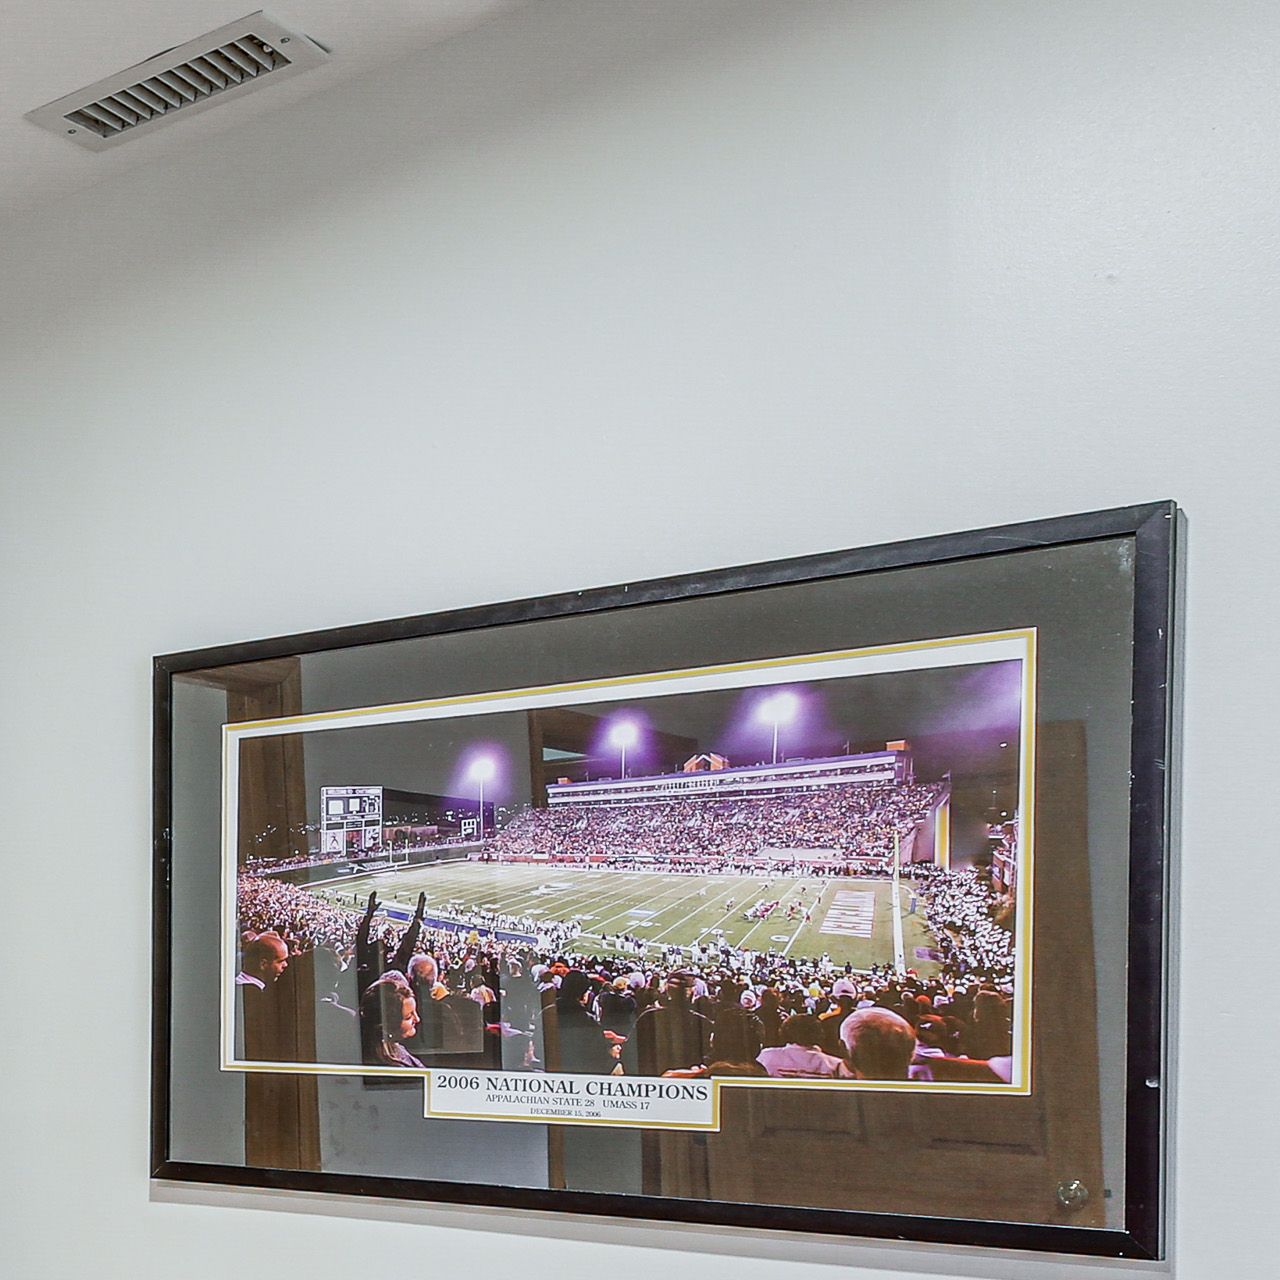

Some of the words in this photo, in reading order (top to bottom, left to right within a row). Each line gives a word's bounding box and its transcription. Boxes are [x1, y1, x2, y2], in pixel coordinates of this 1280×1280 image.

[437, 1075, 480, 1091] 2006
[486, 1077, 580, 1096] NATIONAL
[586, 1081, 709, 1101] CHAMPIONS
[486, 1094, 550, 1105] APPALACHIAN
[552, 1097, 582, 1107] STATE
[584, 1099, 595, 1107] 28
[602, 1100, 638, 1109] UMASS
[640, 1101, 650, 1110] 17
[530, 1107, 573, 1116] DECEMBER
[585, 1110, 602, 1118] 2006
